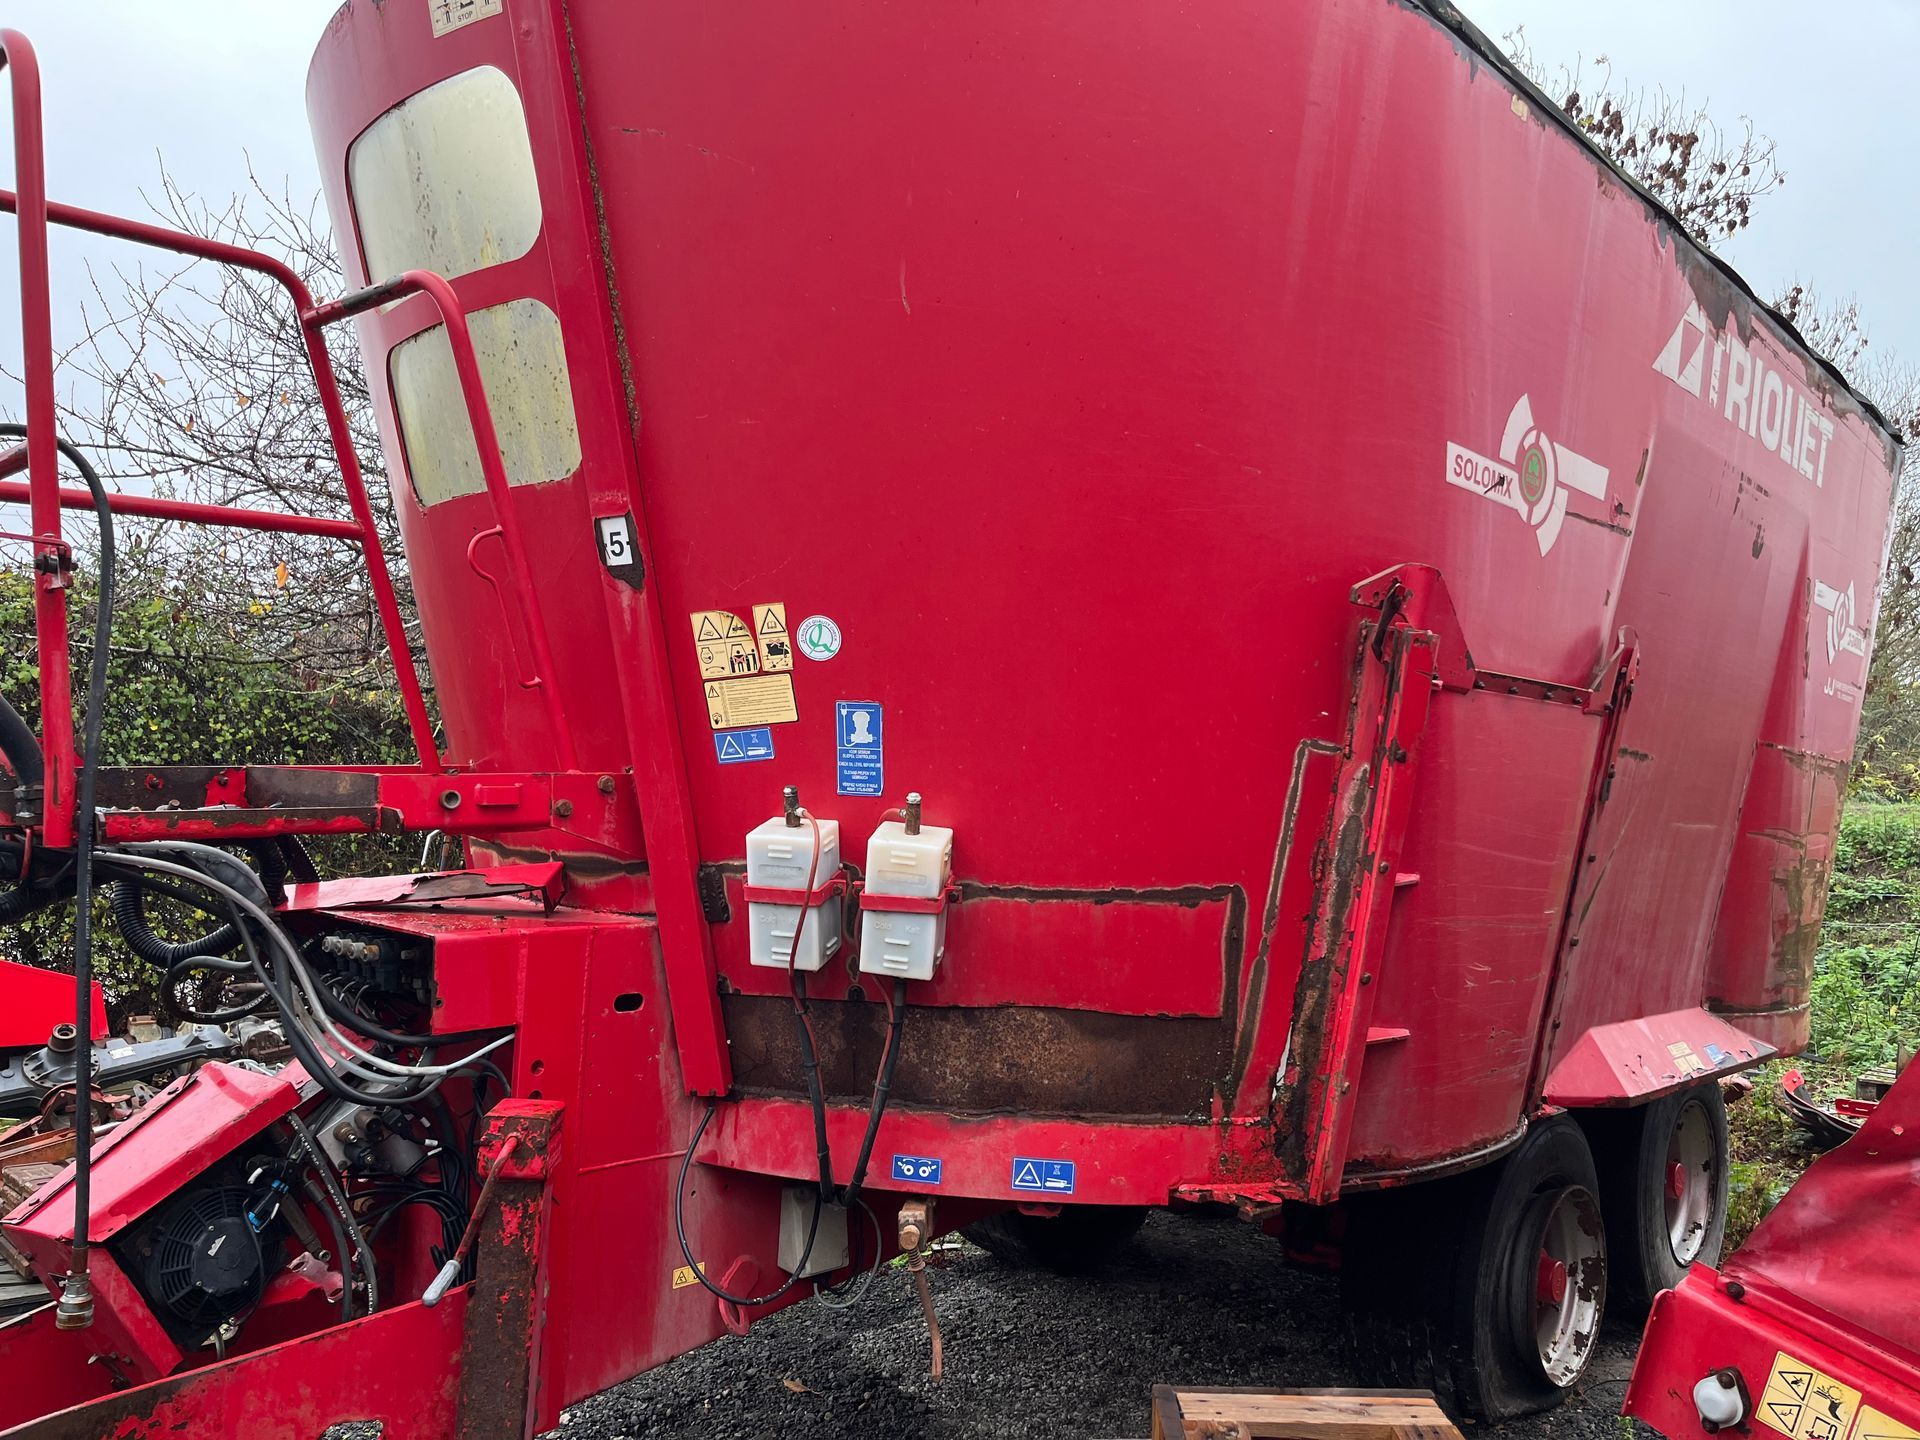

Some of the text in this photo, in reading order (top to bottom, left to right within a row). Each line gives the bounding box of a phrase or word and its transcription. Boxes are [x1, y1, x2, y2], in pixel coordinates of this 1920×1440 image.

[457, 10, 473, 23] STOP
[1708, 331, 1834, 488] TRIOLIET
[610, 531, 624, 557] 5
